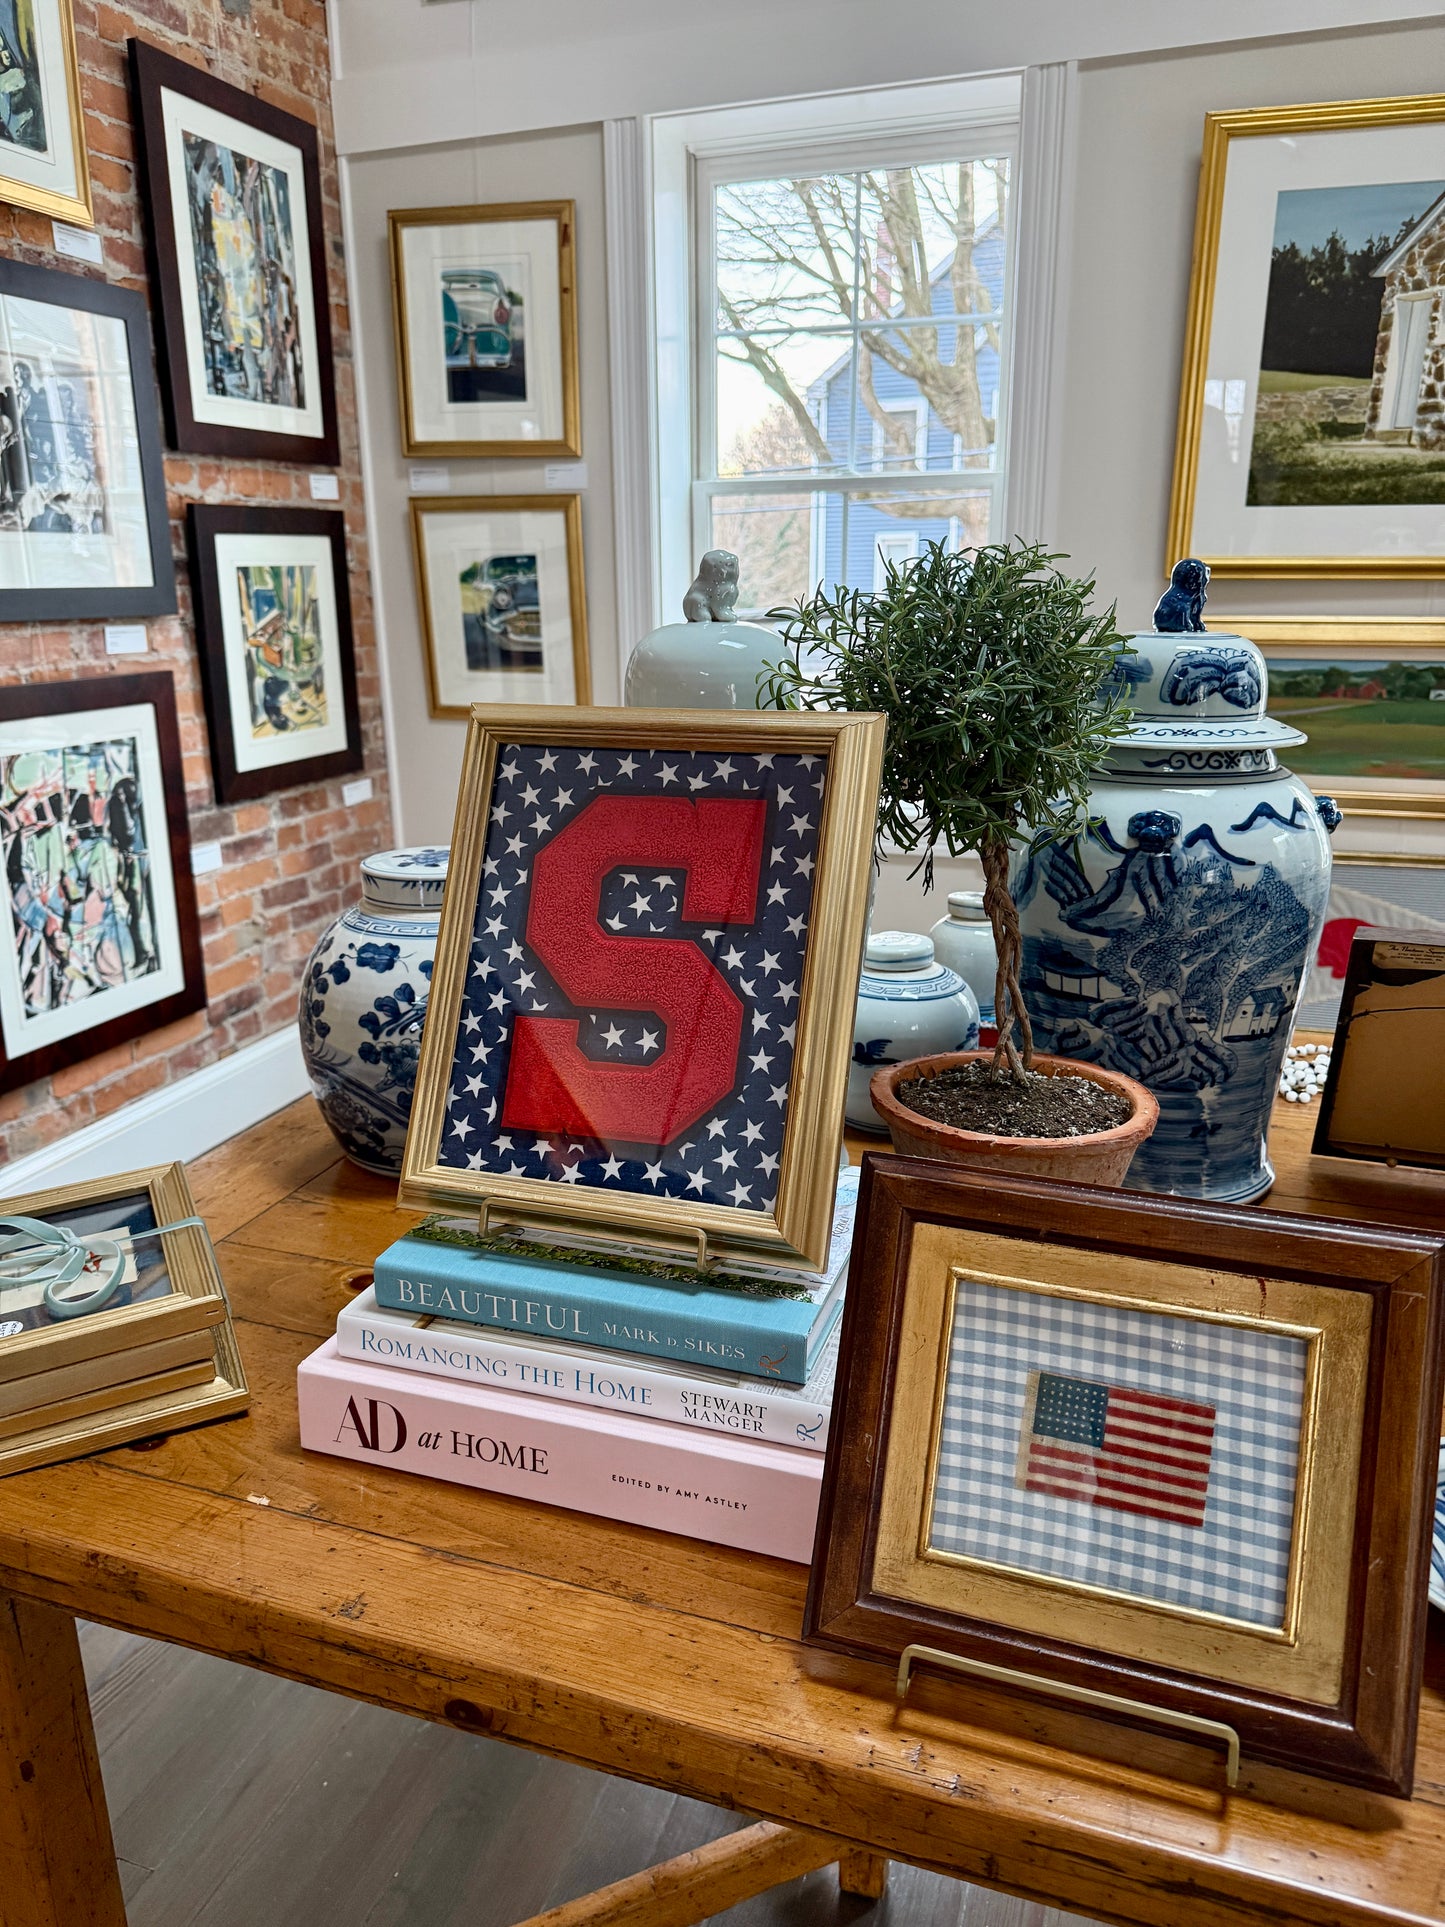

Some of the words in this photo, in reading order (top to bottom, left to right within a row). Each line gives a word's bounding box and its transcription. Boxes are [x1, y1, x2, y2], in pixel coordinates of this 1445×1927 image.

[501, 794, 767, 1145] S
[397, 1279, 589, 1335] BEAUTIFUL
[603, 1322, 660, 1344] MARK
[684, 1338, 745, 1360] SIKES
[361, 1329, 508, 1377] ROMANCING
[516, 1363, 565, 1389] THE
[575, 1370, 653, 1406] HOME
[680, 1391, 767, 1419] STEWART
[684, 1406, 765, 1433] MANGER
[332, 1394, 408, 1454] AD
[417, 1431, 443, 1450] at
[450, 1429, 549, 1475] HOME
[611, 1474, 651, 1489] EDITED
[657, 1484, 670, 1493] BY
[676, 1488, 699, 1500] AMY
[705, 1496, 748, 1511] ASTLEY
